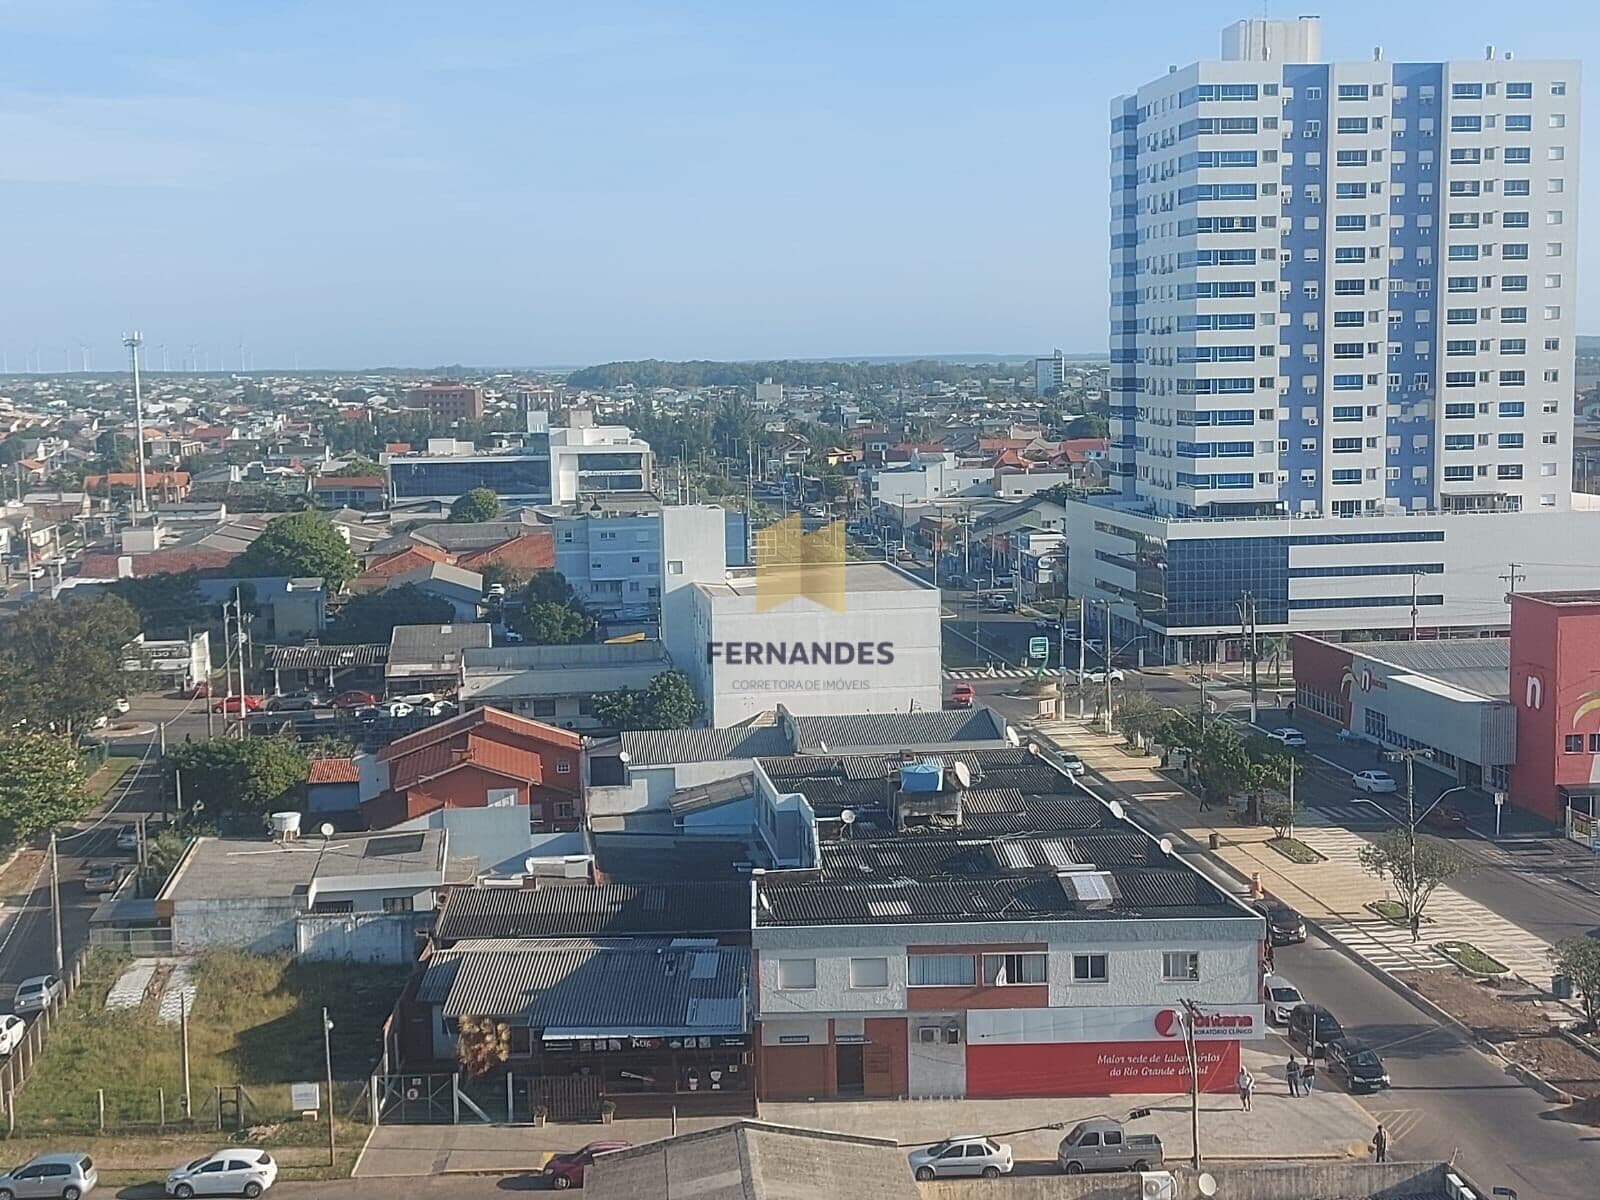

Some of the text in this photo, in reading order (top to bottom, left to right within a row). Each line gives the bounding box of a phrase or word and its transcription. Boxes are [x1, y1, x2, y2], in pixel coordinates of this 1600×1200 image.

[1097, 1053, 1125, 1065] Maior
[1127, 1054, 1148, 1064] rede
[1149, 1053, 1161, 1064] de
[1109, 1067, 1121, 1077] do
[1123, 1066, 1138, 1077] Rio
[1141, 1065, 1175, 1076] Grande
